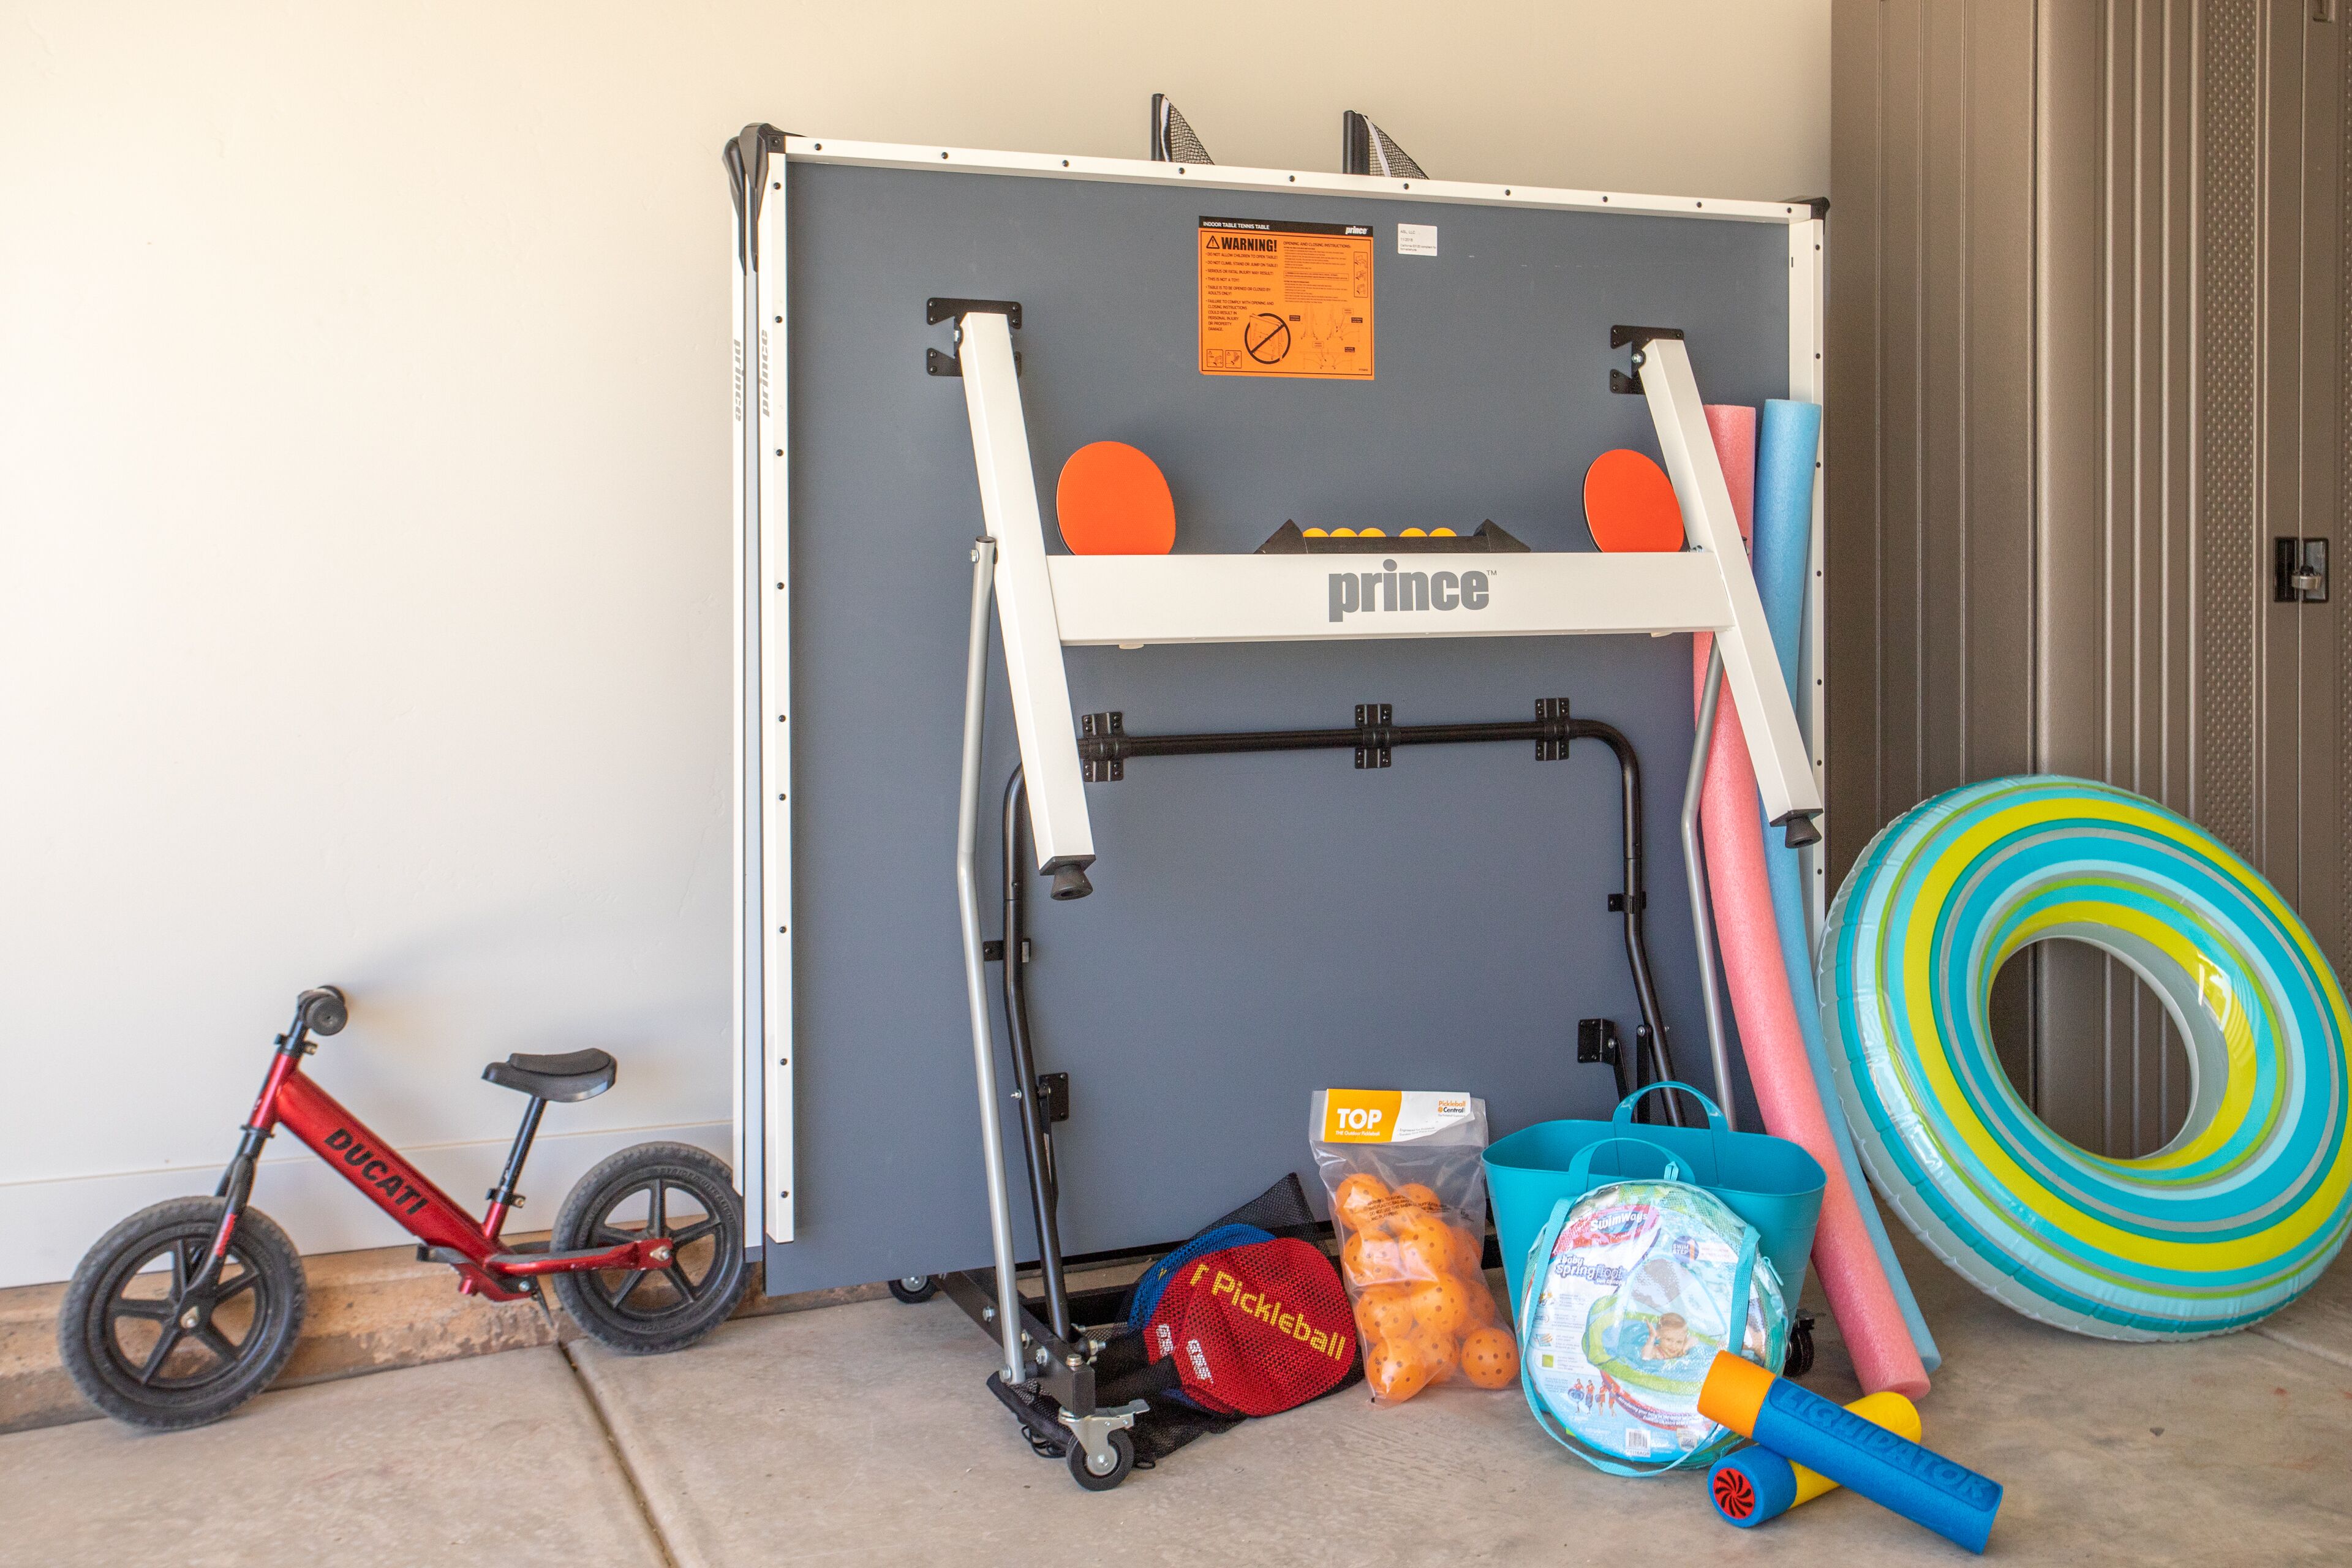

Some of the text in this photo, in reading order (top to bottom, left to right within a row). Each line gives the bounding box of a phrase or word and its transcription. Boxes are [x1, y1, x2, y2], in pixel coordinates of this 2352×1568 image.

[1345, 225, 1367, 235] prince
[1221, 237, 1277, 252] WARNING!
[734, 339, 744, 421] prince
[760, 330, 769, 418] prince
[1329, 559, 1490, 622] prince
[1337, 1109, 1382, 1129] TOP
[324, 1128, 428, 1215] DUCATI
[1590, 1212, 1648, 1231] SwimWays
[1562, 1254, 1584, 1265] baby
[1687, 1238, 1695, 1261] 1
[1211, 1270, 1346, 1361] Pickleball
[1618, 1396, 1638, 1412] Introducing
[1779, 1385, 1994, 1499] LIQUIDATOR
